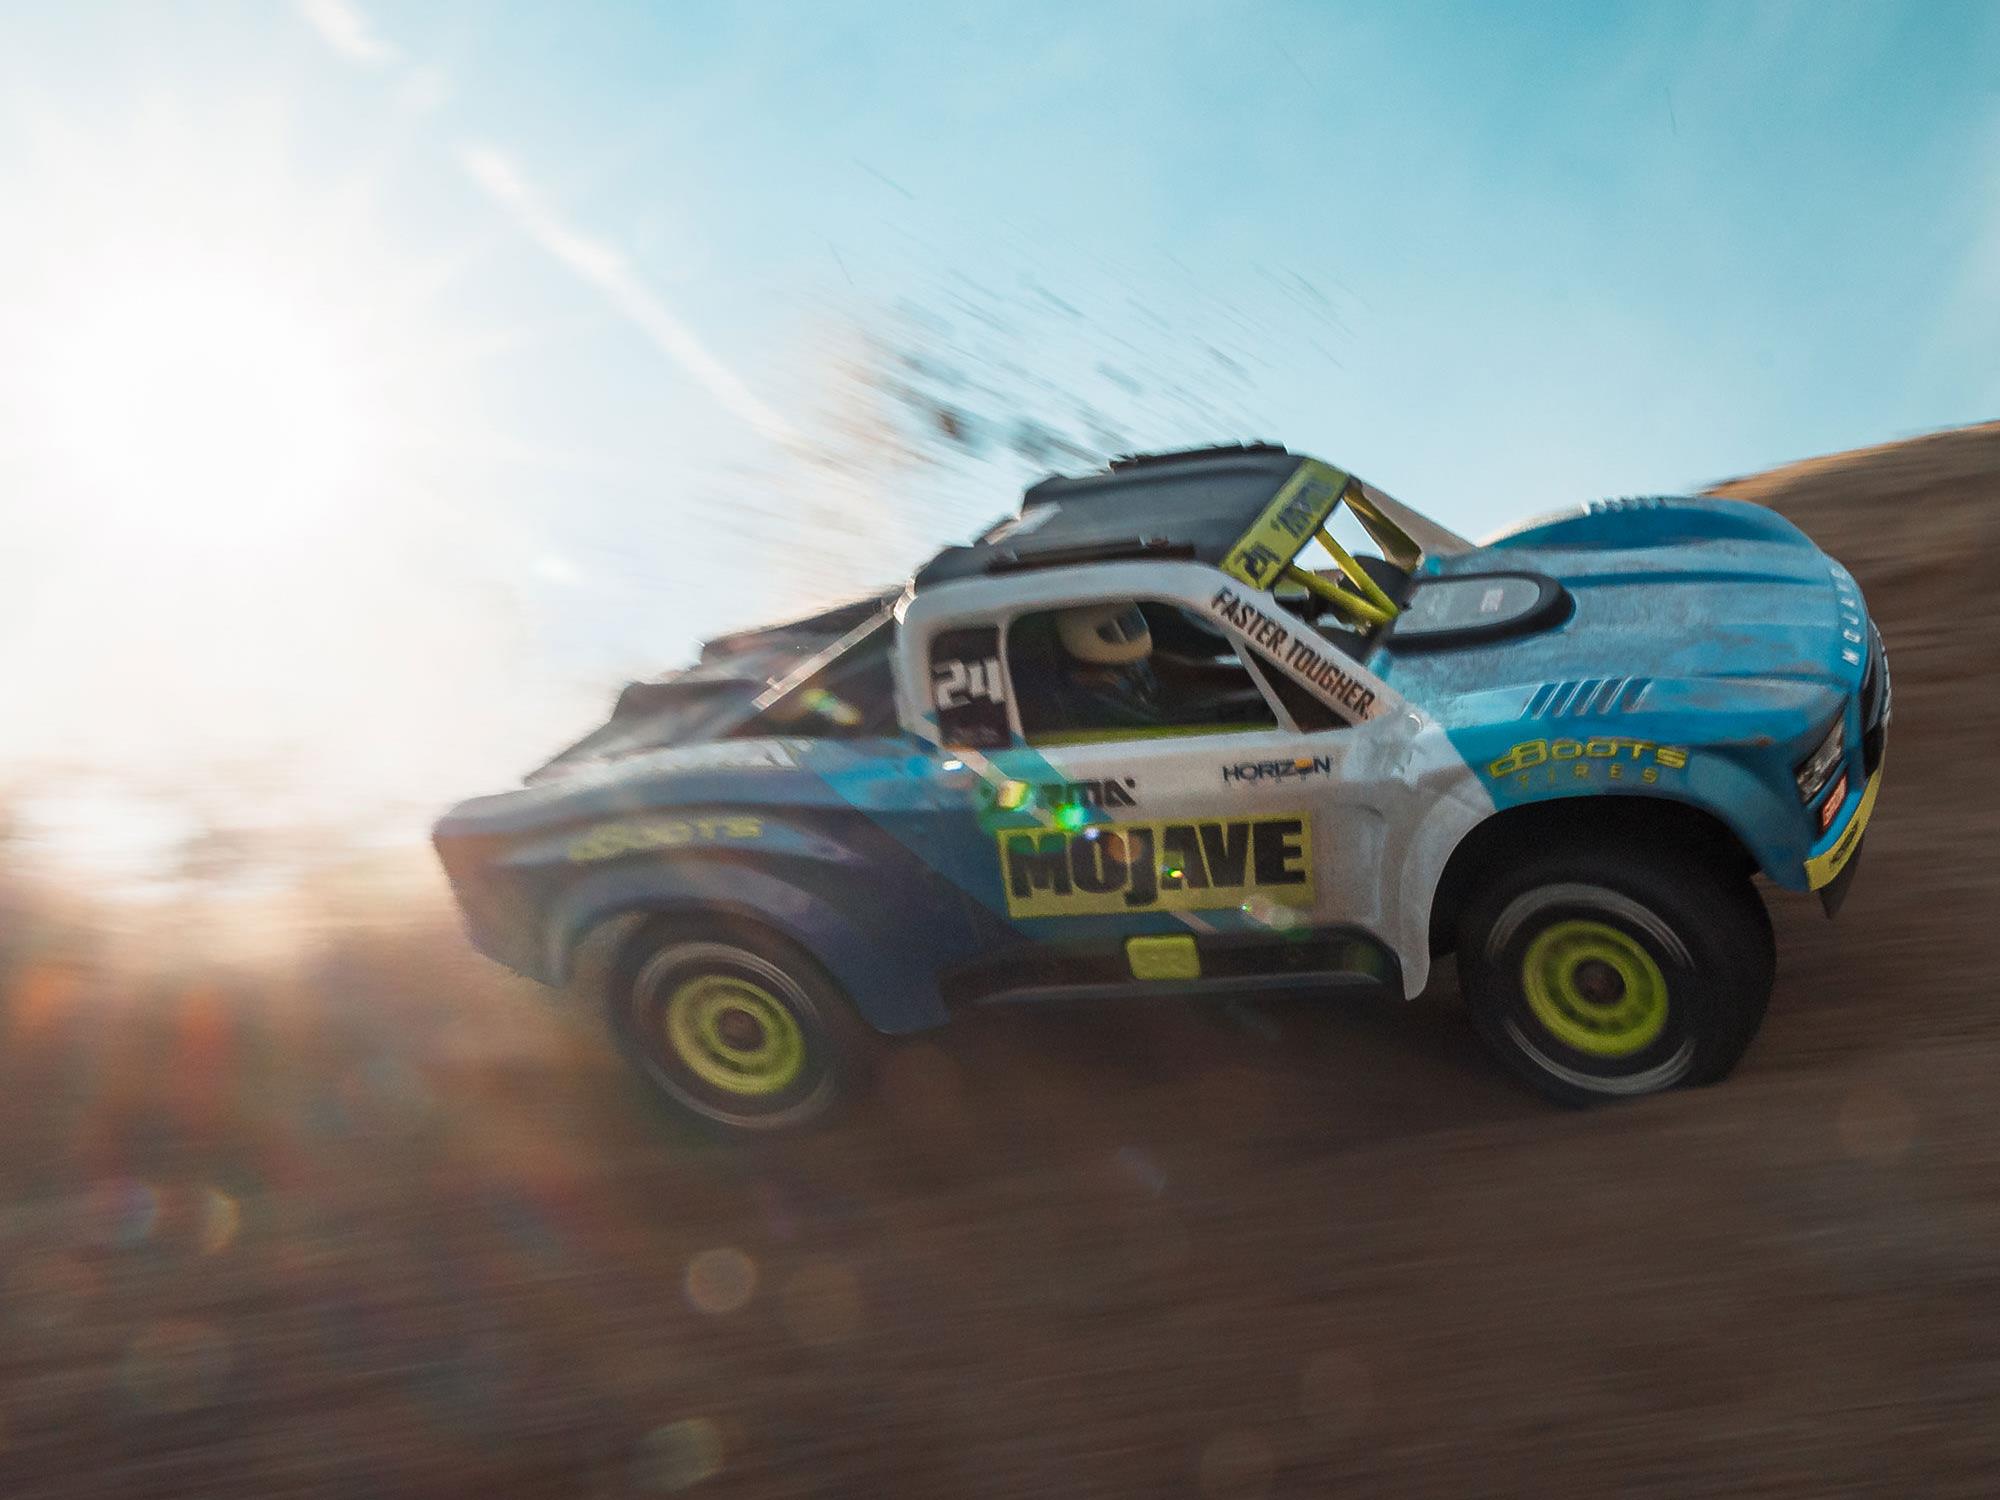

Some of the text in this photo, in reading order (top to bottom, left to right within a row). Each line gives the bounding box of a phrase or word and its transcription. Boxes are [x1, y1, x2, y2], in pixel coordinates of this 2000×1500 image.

[934, 658, 1003, 711] 24
[1285, 637, 1376, 720] TOUGHER.
[1222, 755, 1331, 781] HORIZON
[1006, 820, 1307, 907] MOJAVE
